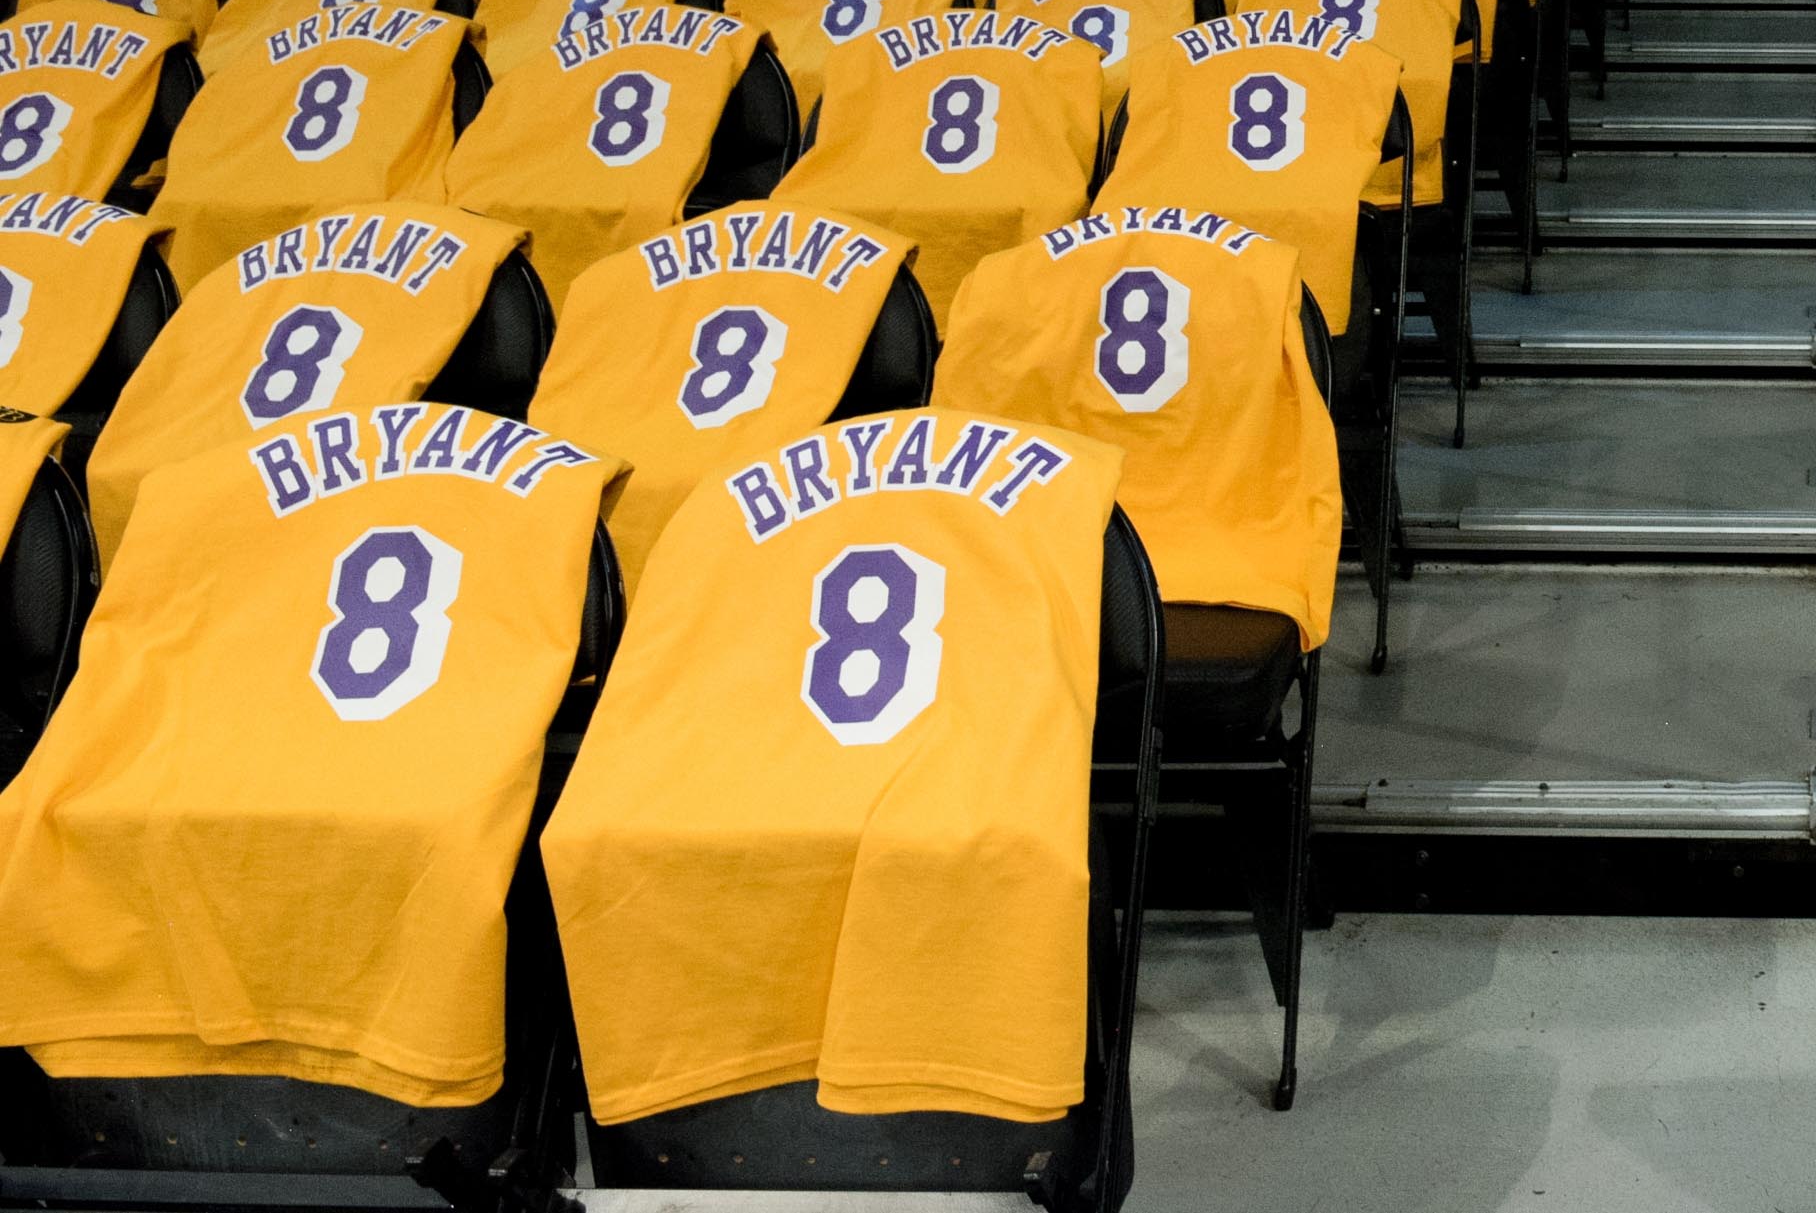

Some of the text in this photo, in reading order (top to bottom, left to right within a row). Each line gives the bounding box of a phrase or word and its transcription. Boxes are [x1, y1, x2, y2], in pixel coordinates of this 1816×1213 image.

[0, 22, 149, 79] RYANT
[876, 10, 1072, 71] BRYANT
[1068, 4, 1130, 68] 8
[1173, 2, 1373, 65] BRYANT
[0, 92, 73, 180] 8
[282, 65, 368, 161] 8
[588, 71, 671, 167] 8
[921, 75, 999, 173] 8
[1228, 72, 1306, 171] 8
[237, 214, 467, 296] BRYANT
[640, 212, 888, 292] BRYANT
[1041, 207, 1269, 260] BRYANT
[240, 303, 363, 438] 8
[677, 306, 788, 429] 8
[1095, 267, 1190, 412] 8
[242, 400, 598, 518] BRYANT
[725, 415, 1072, 544] BRYANT
[310, 525, 463, 721] 8
[800, 543, 946, 746] 8
